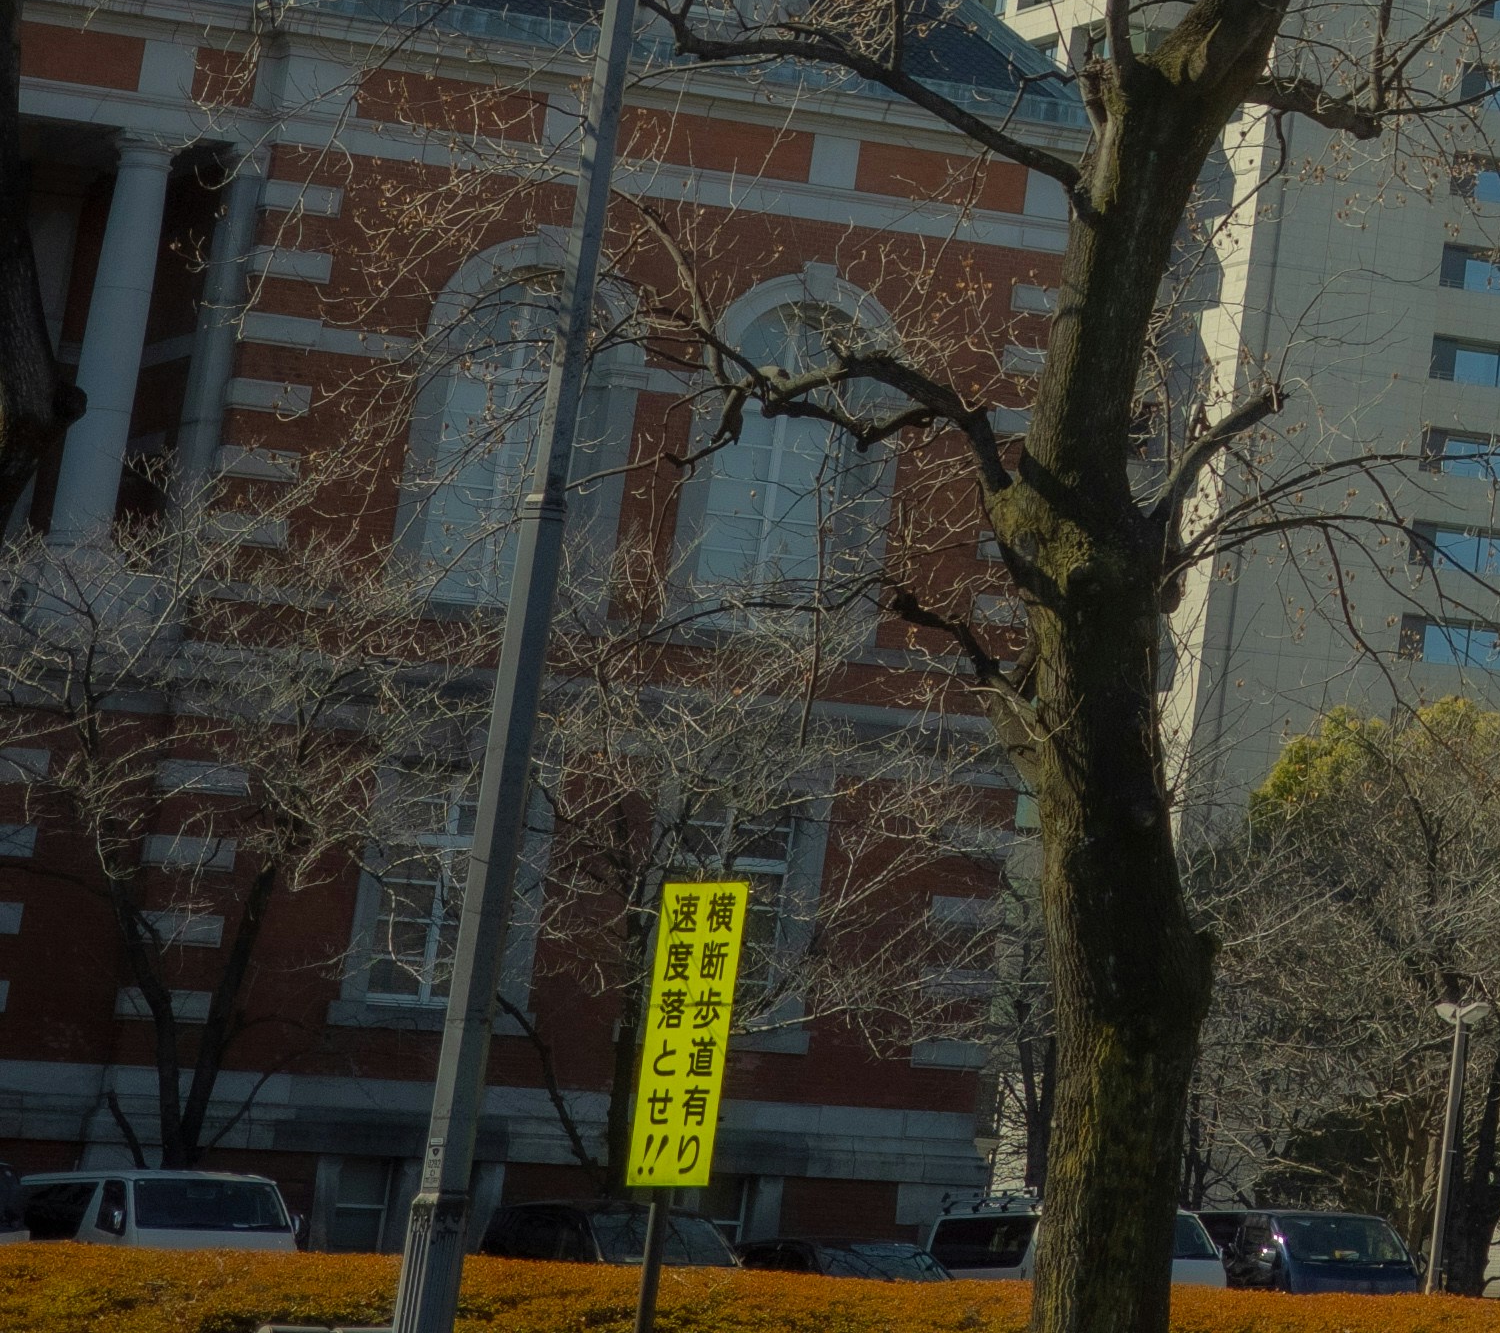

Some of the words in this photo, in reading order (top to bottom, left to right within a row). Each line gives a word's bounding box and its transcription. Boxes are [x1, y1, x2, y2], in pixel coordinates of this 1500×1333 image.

[676, 892, 736, 1175] 横断歩道有り
